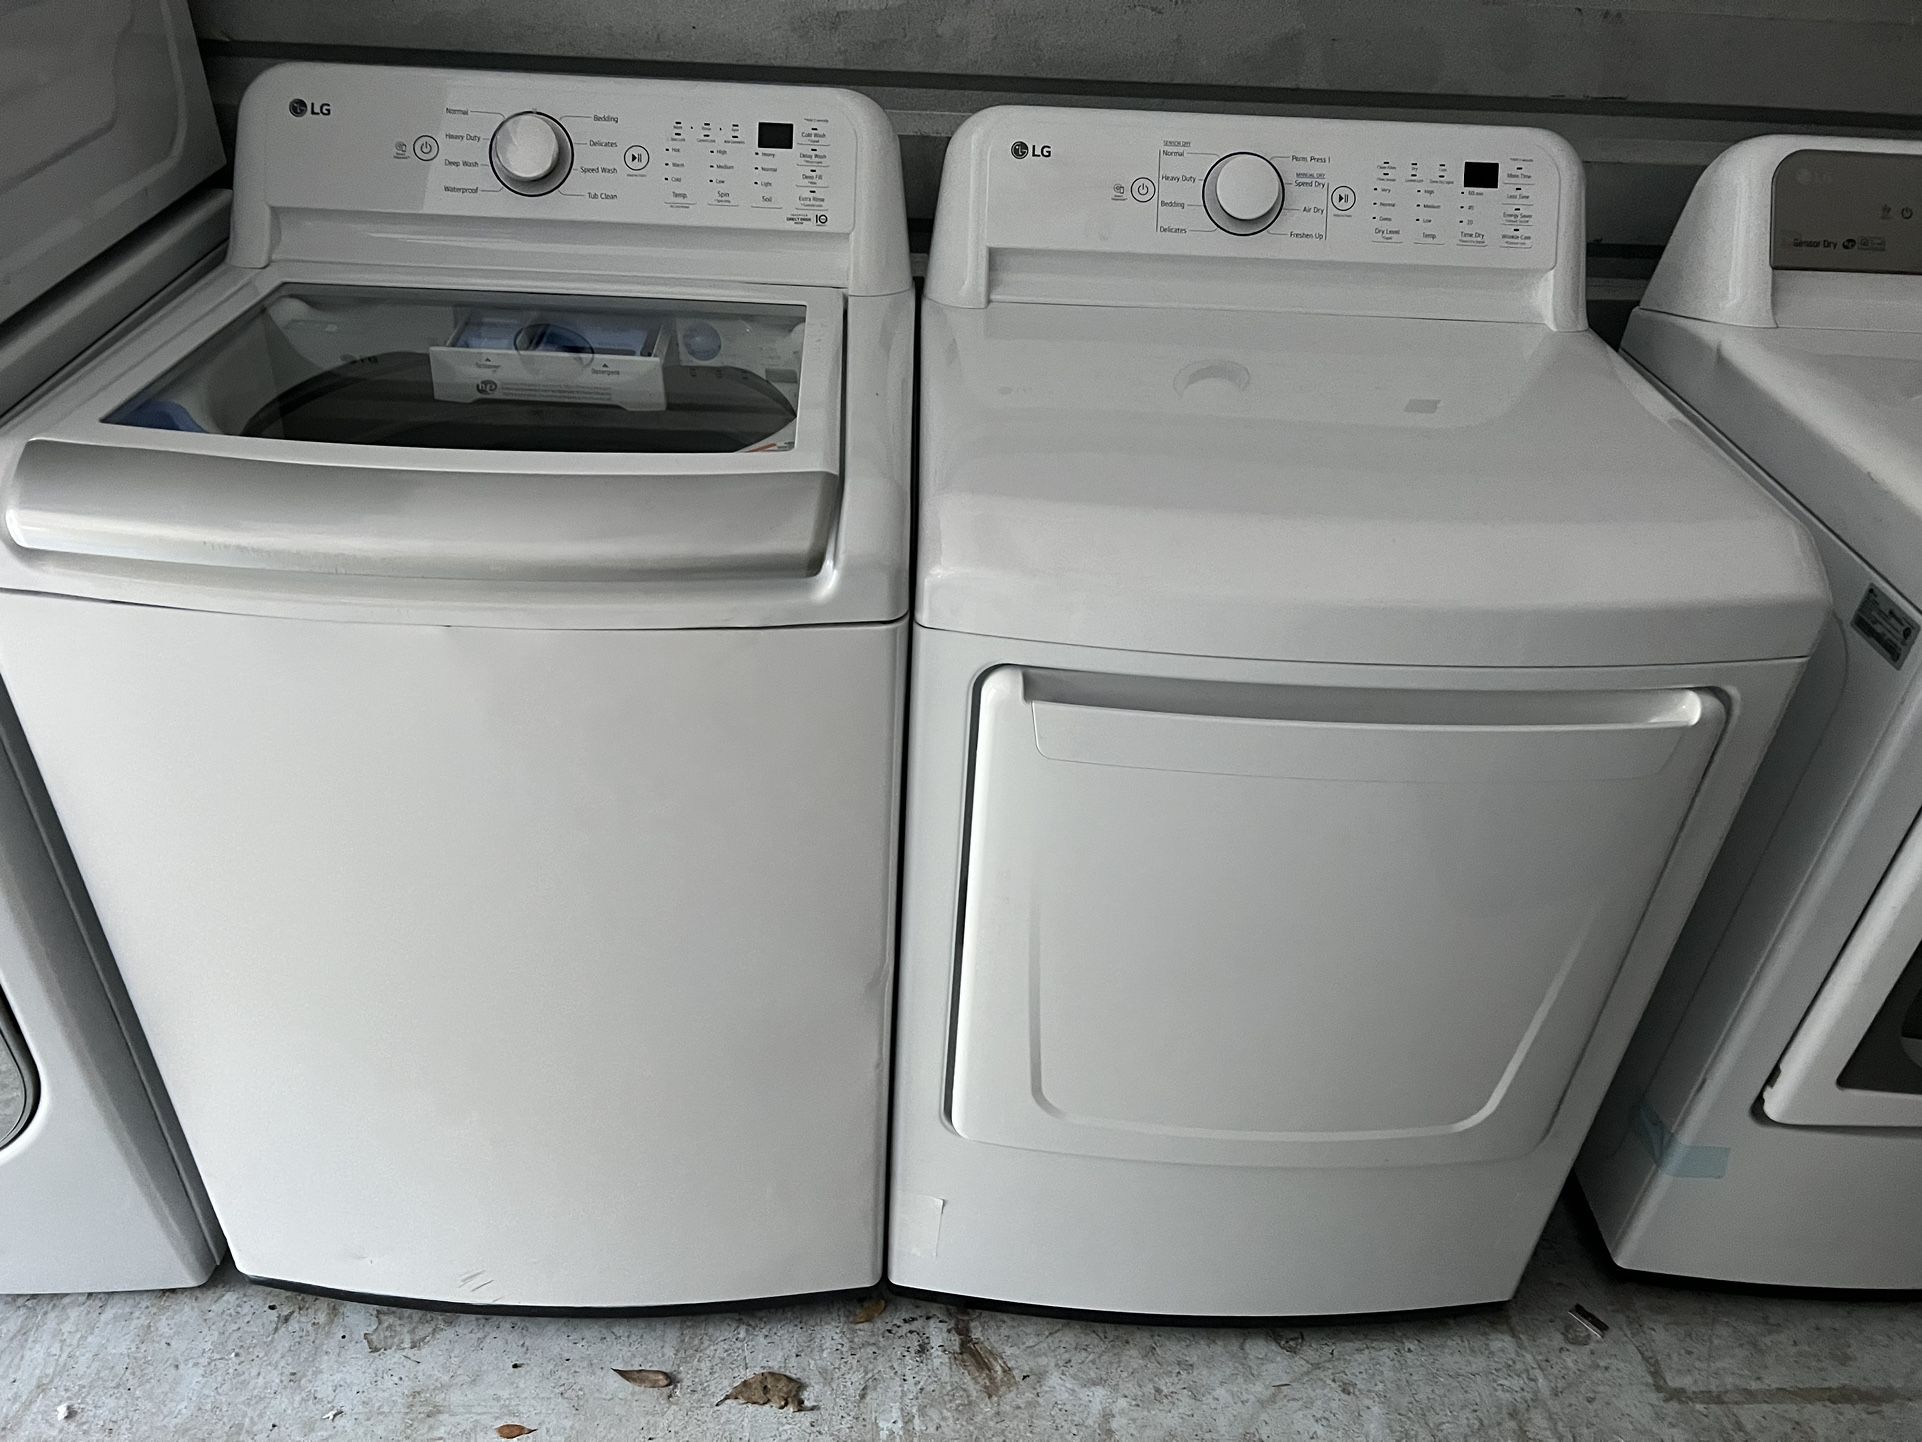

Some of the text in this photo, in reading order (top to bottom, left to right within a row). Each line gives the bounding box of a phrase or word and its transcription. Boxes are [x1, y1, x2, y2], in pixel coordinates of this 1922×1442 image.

[310, 102, 331, 116] LG
[446, 107, 469, 115] Normal
[593, 114, 619, 123] Bedding
[445, 133, 480, 142] Heavy Duty
[1032, 145, 1052, 158] LG
[444, 159, 460, 167] Deep
[1310, 155, 1327, 163] Press
[580, 166, 599, 174] Speed
[1161, 174, 1196, 183] Heavy Duty
[1294, 180, 1325, 189] Speed Dry
[444, 185, 479, 194] Waterproof
[717, 190, 730, 198] Spin
[600, 192, 618, 200] Clean
[1160, 200, 1185, 209] Bedding
[1313, 206, 1324, 215] Dry
[1159, 226, 1187, 234] Delicates
[1374, 227, 1385, 236] Dry
[1290, 231, 1324, 240] Freshen Up
[1474, 232, 1485, 240] Dry
[1792, 237, 1821, 248] Sensor
[1822, 239, 1838, 250] Dry
